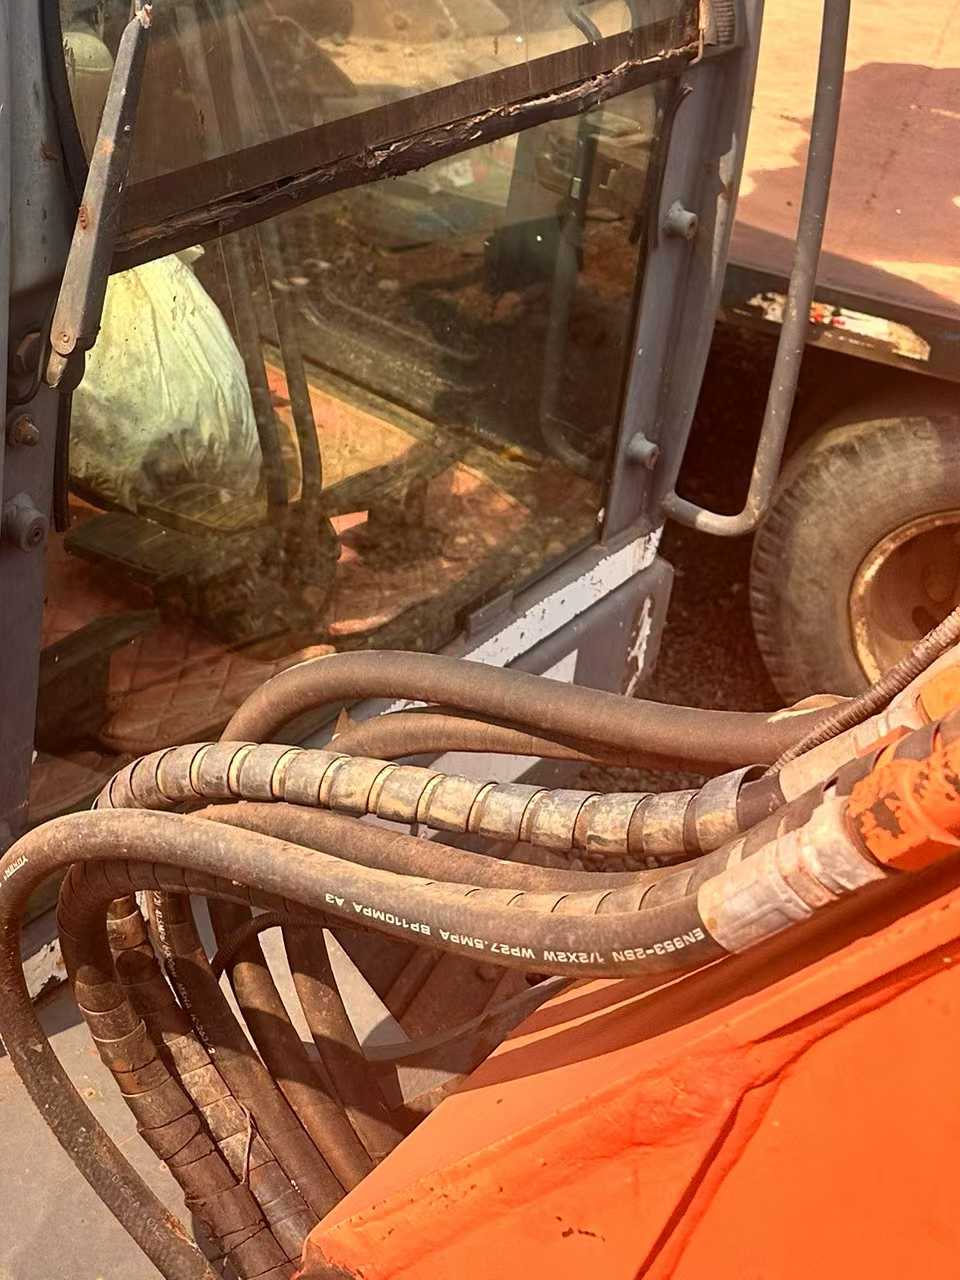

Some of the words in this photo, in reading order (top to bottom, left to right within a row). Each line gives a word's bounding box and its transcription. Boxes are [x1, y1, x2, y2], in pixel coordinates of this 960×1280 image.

[325, 893, 344, 907] A3
[352, 902, 431, 935] BP110MPA
[439, 930, 535, 960] WP27.5MPA
[543, 950, 604, 963] 1/2X2W
